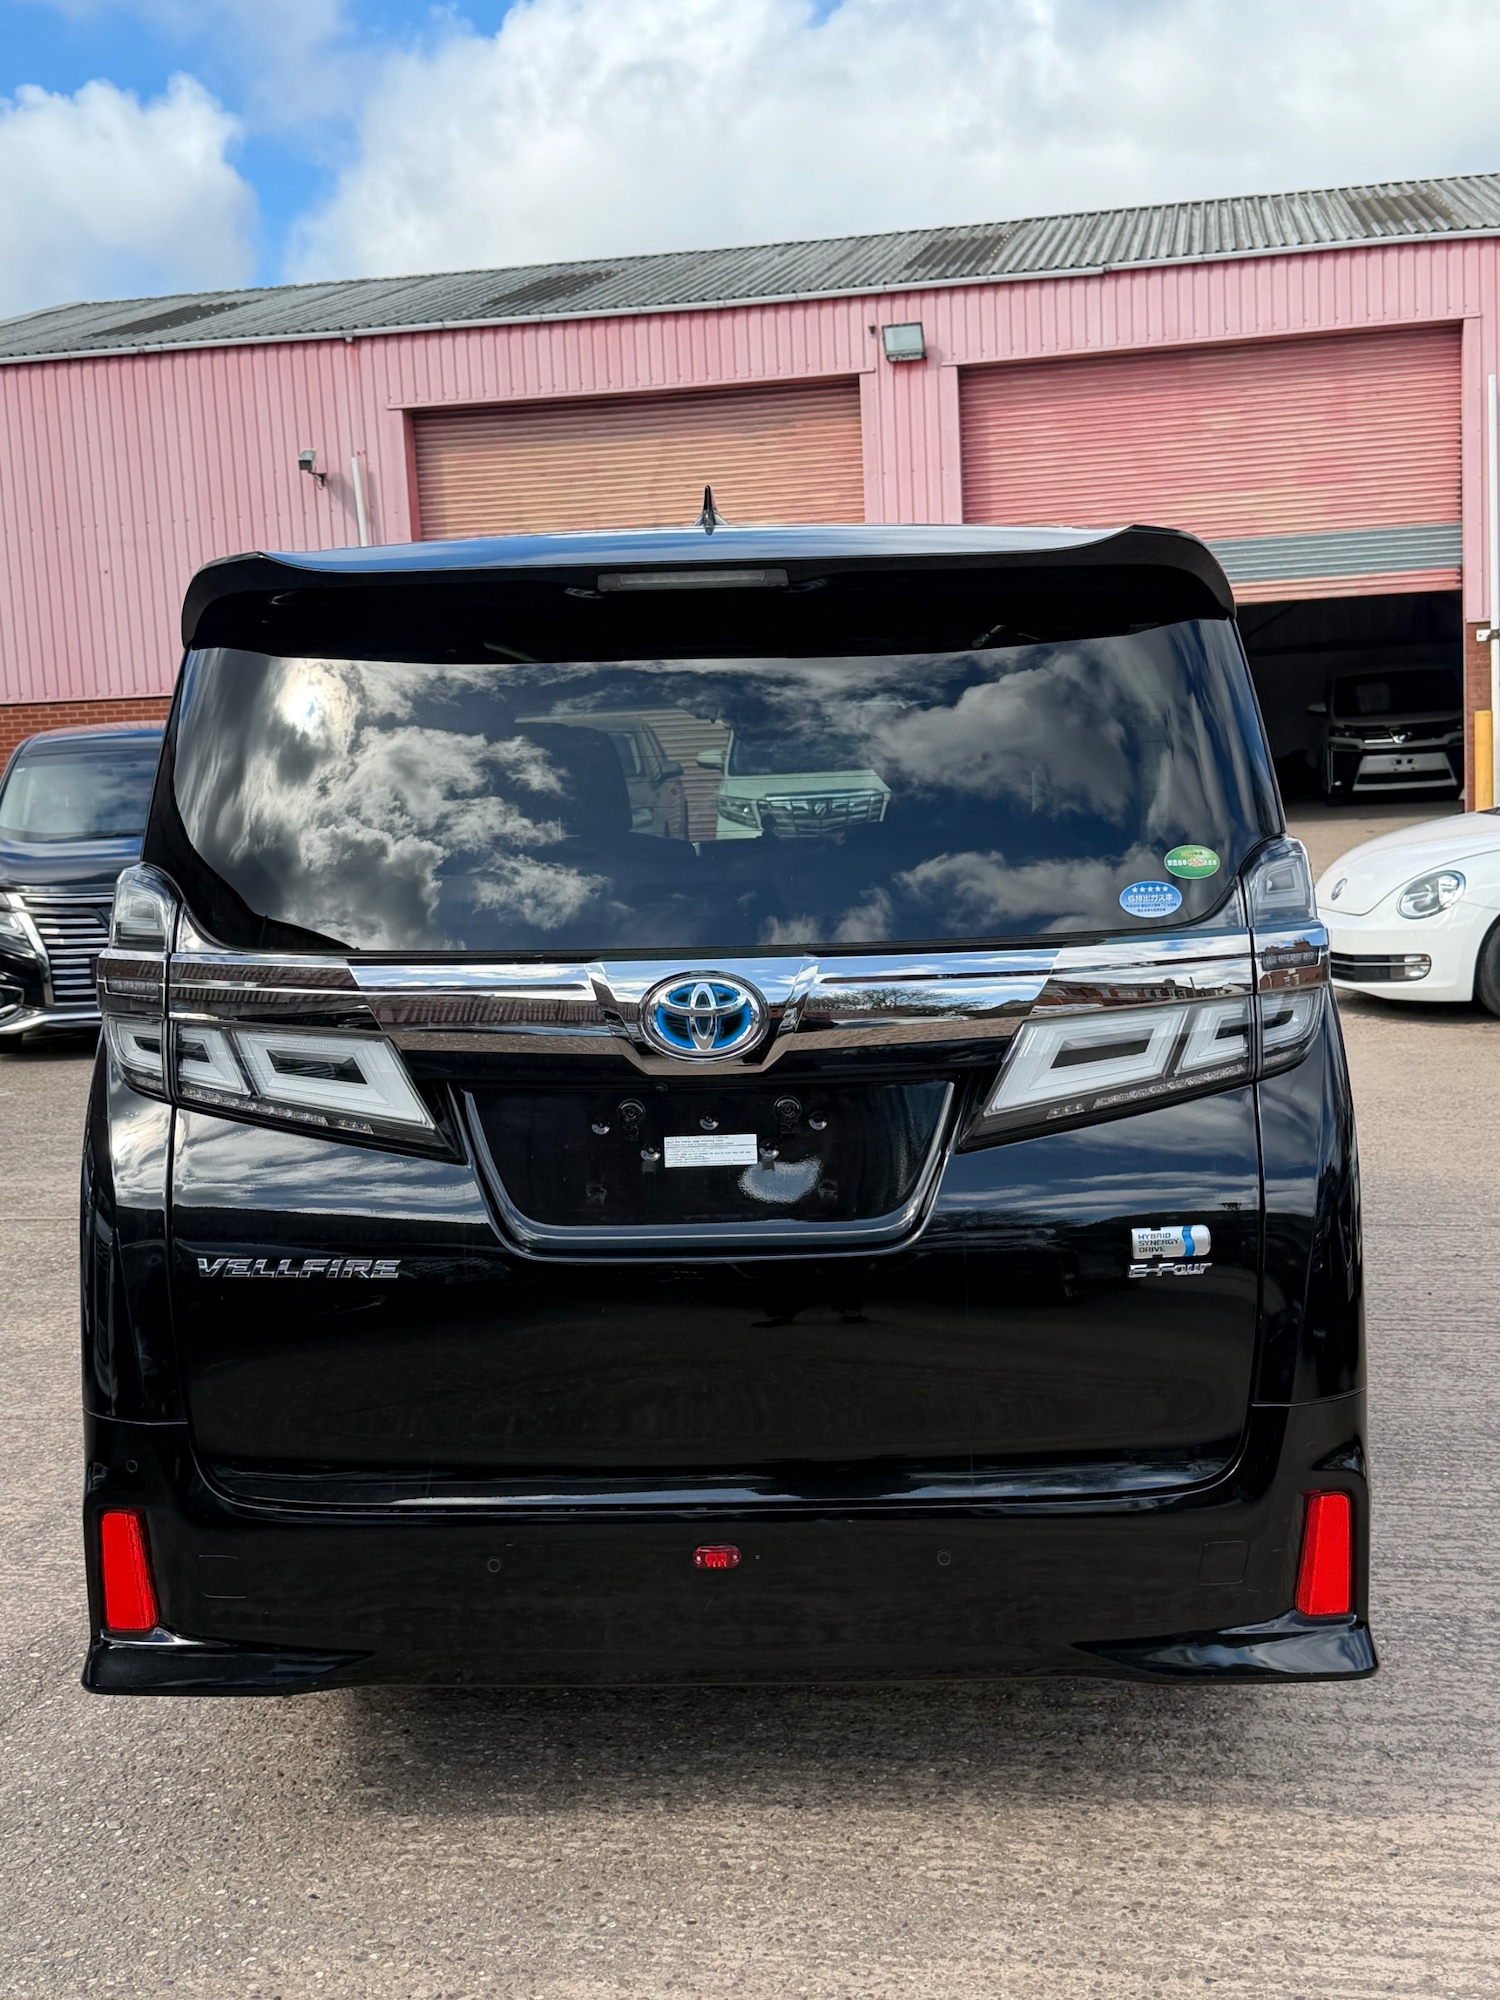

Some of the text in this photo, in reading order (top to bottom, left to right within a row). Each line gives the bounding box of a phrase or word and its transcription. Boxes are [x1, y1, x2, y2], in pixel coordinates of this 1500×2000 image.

[1138, 1232, 1171, 1240] HYBRID
[1138, 1238, 1180, 1247] SYNERGY
[197, 1257, 401, 1279] VELLFIRE
